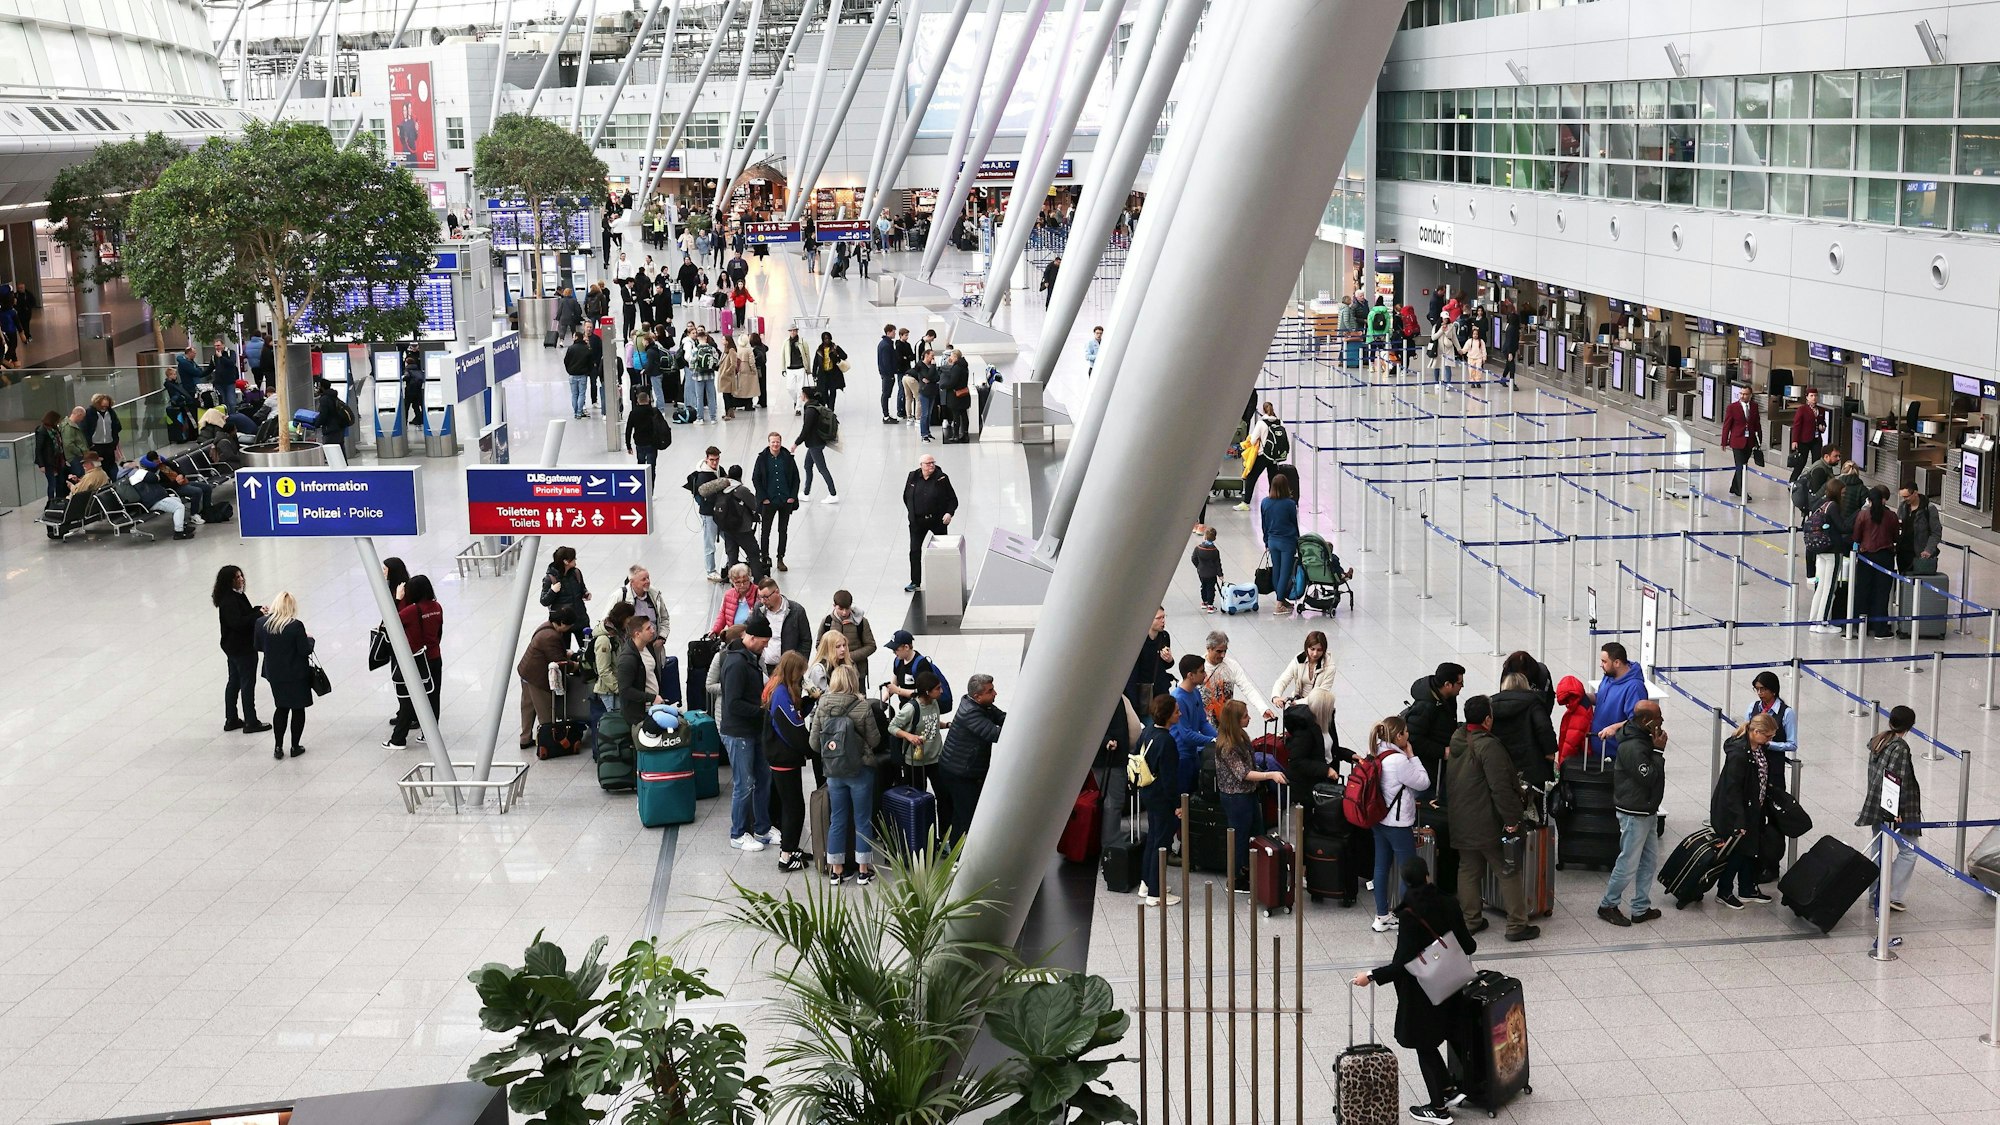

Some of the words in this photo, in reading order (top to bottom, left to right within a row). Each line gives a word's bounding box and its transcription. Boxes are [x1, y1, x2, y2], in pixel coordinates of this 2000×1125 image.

[390, 74, 396, 91] 2
[407, 73, 412, 90] 1
[1419, 224, 1445, 245] condor
[1983, 384, 1996, 397] 179
[300, 480, 369, 492] Information
[535, 486, 562, 496] Priority
[564, 486, 580, 495] lane
[303, 507, 341, 519] Polizei
[349, 507, 384, 518] Police
[496, 507, 540, 516] Toiletten
[510, 518, 541, 528] Toilets
[658, 737, 681, 747] idas
